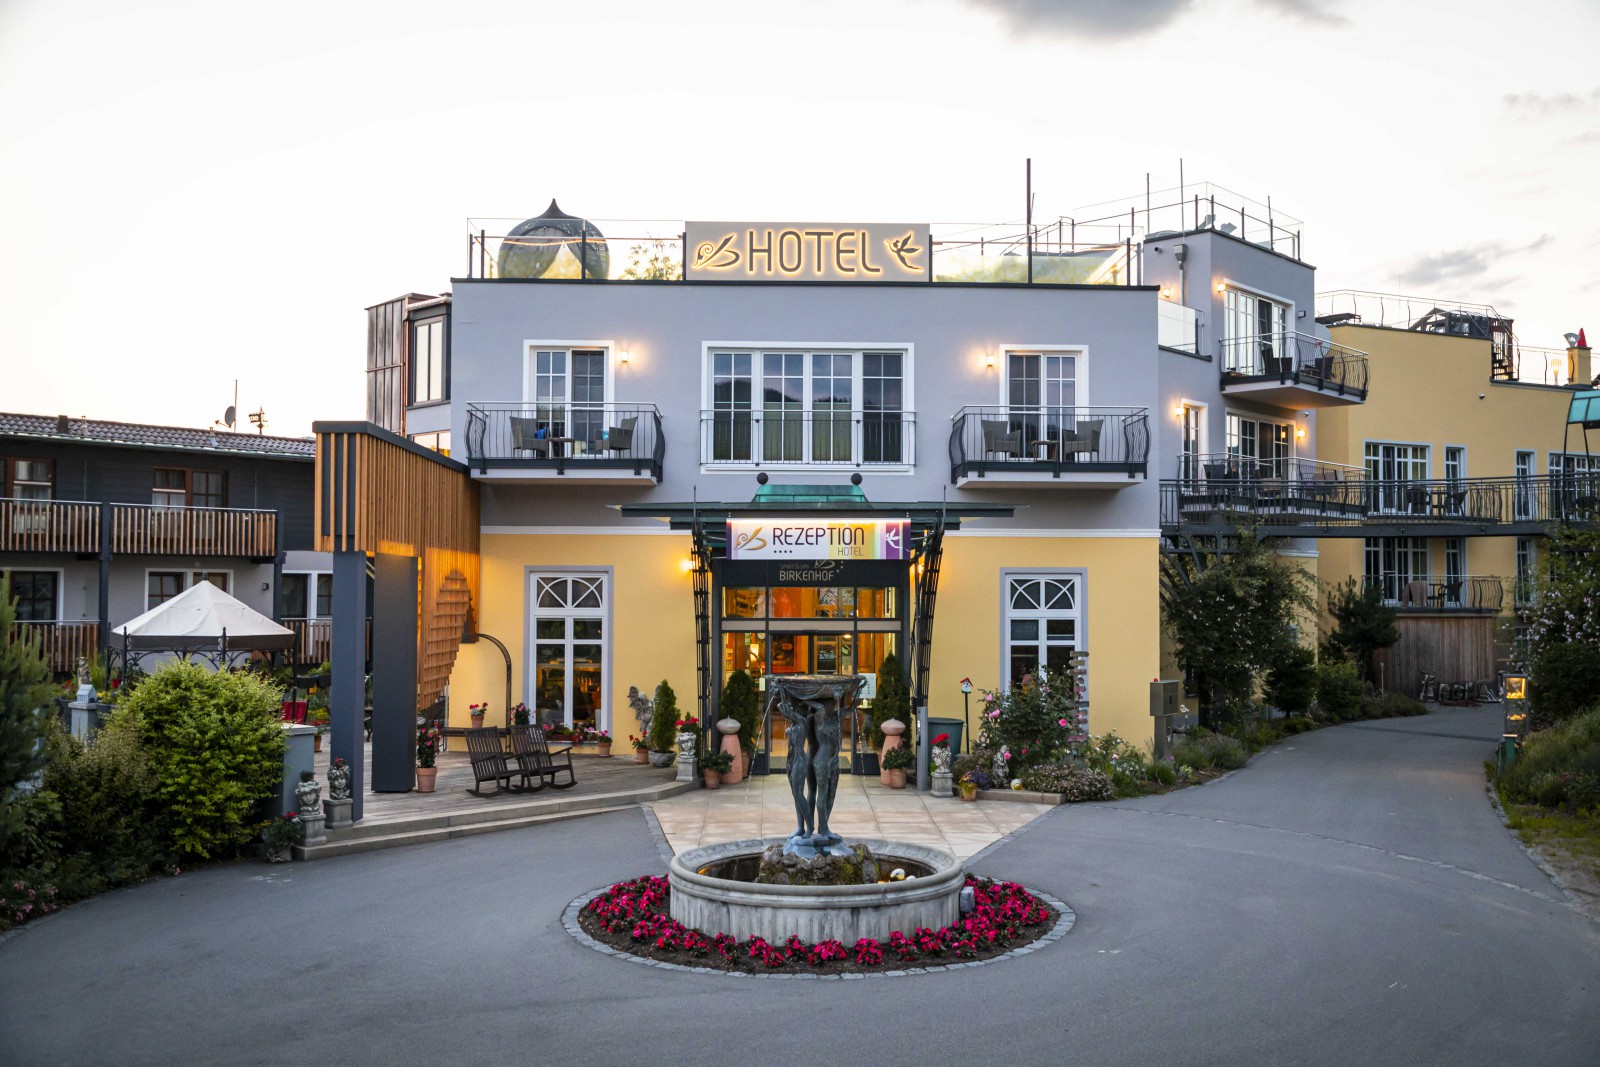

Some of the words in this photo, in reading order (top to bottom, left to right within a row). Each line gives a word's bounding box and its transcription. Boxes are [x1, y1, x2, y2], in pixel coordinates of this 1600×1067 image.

[748, 229, 881, 273] HOTEL
[772, 527, 865, 546] REZEPTION
[837, 546, 865, 557] HOTEL
[779, 570, 834, 581] BIRKENHOF
